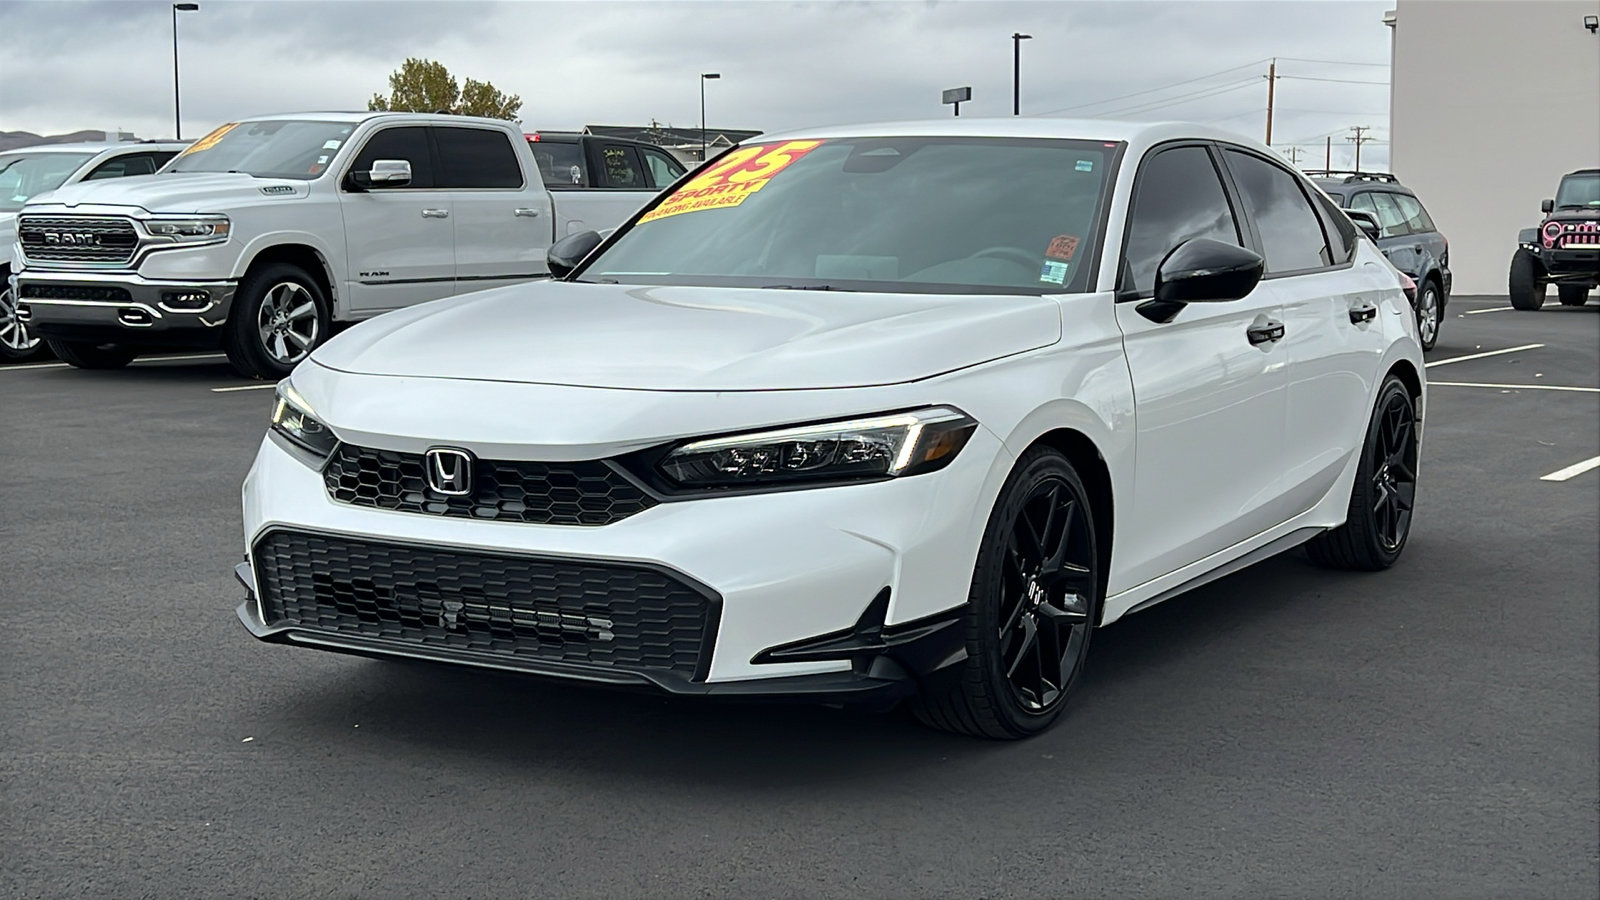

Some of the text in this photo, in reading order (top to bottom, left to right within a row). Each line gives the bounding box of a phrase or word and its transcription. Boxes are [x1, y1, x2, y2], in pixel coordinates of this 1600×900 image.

[679, 140, 821, 188] 25
[664, 180, 763, 206] SPORTY
[690, 194, 746, 209] AVAILABLE
[44, 233, 94, 244] RAM
